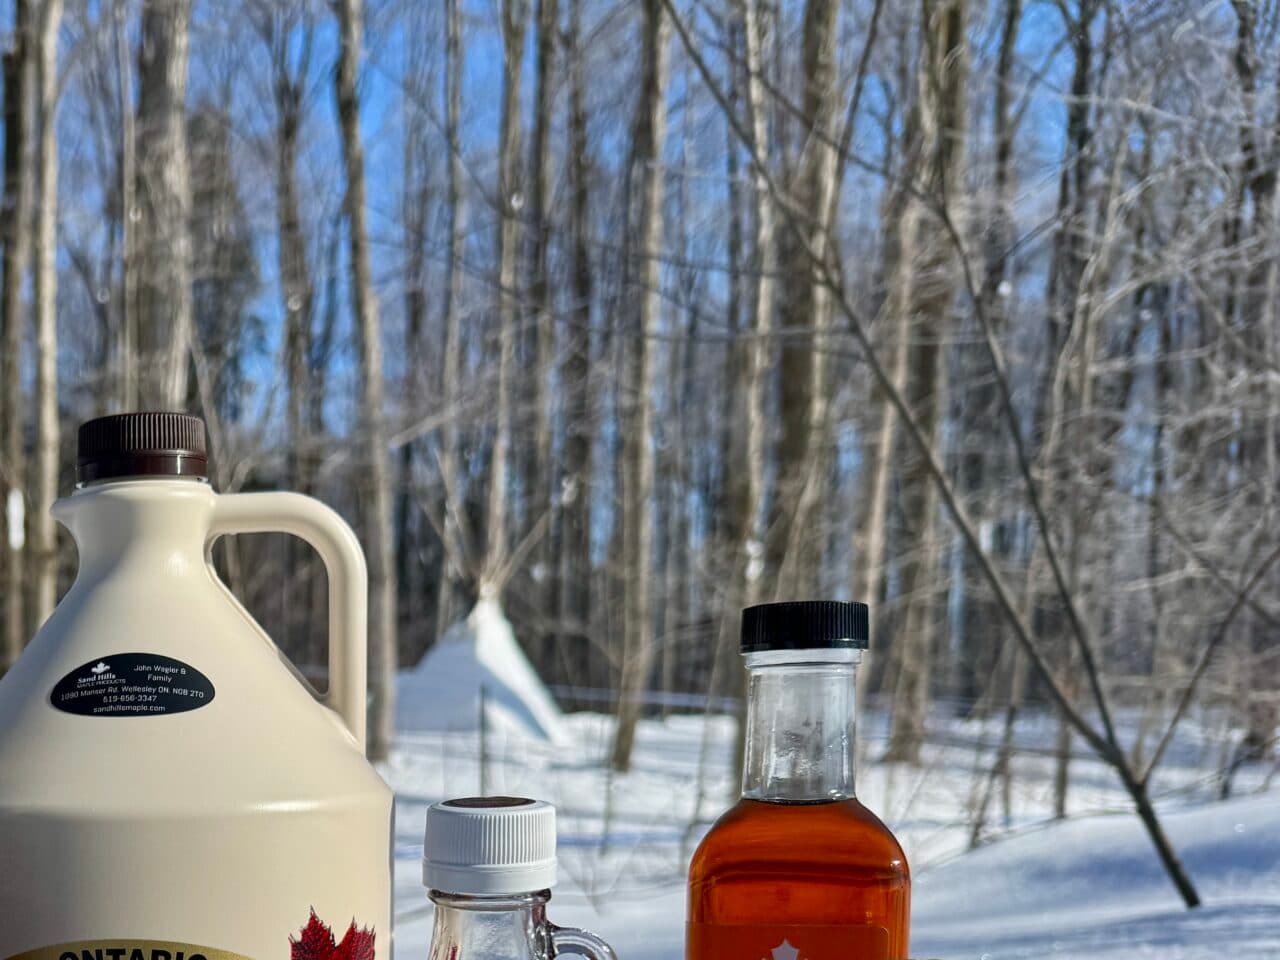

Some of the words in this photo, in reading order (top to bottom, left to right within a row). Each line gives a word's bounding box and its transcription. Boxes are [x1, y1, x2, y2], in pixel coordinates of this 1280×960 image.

[134, 664, 152, 672] John
[77, 676, 96, 684] Sand
[148, 673, 172, 683] Family
[93, 704, 166, 714] sandhillsmaple.com
